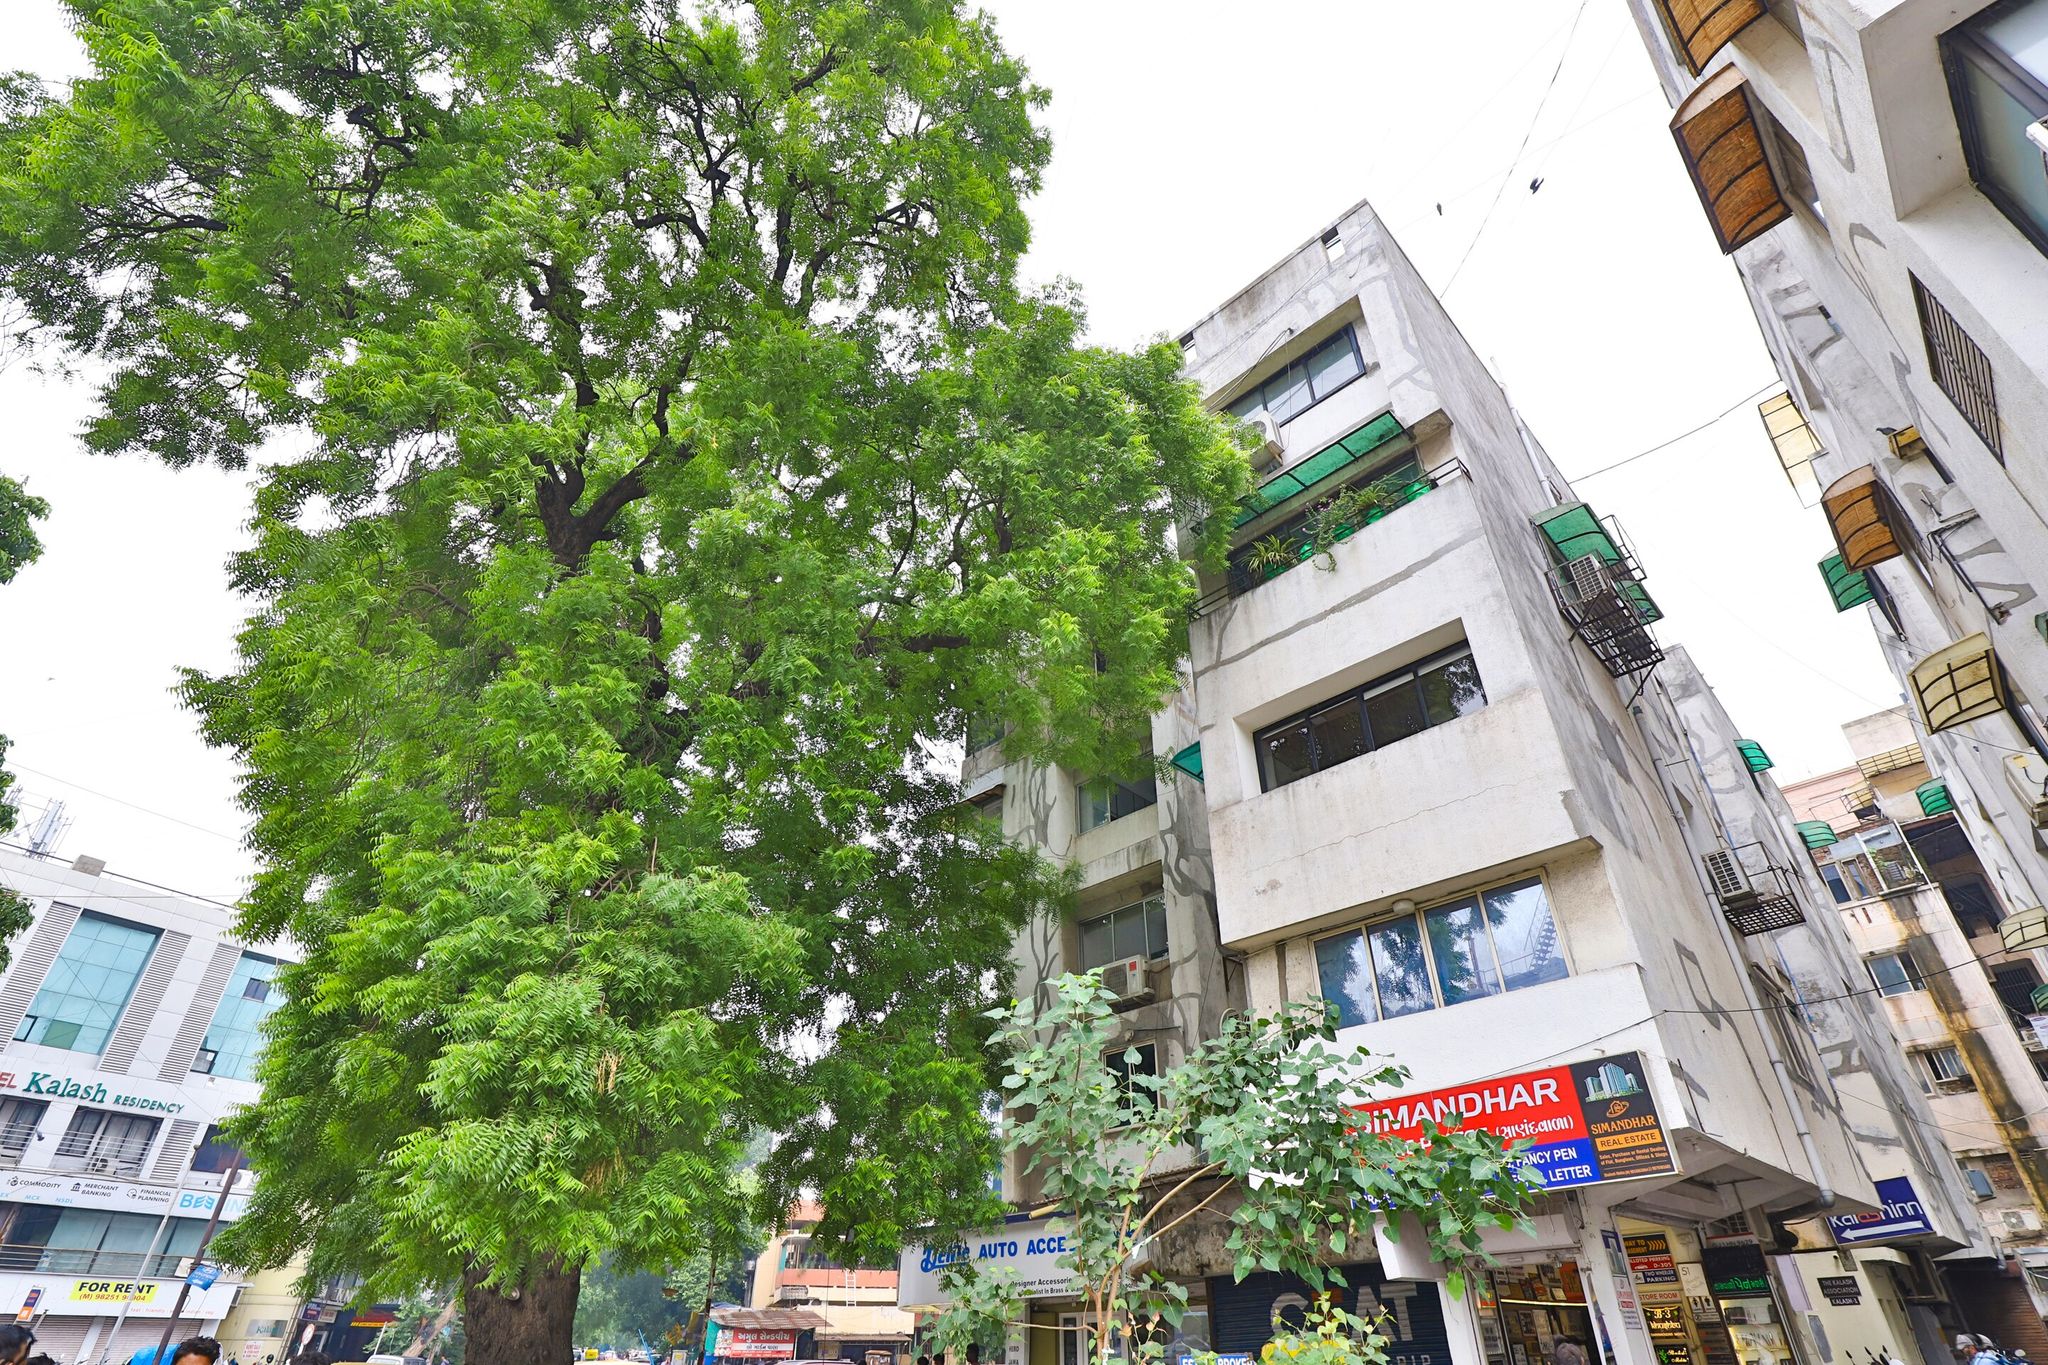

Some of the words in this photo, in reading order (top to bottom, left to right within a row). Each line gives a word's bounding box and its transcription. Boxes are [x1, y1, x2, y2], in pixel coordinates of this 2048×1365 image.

[23, 1072, 107, 1103] Kalash
[113, 1095, 184, 1113] RESIDENCY
[1591, 1115, 1657, 1135] SIMANDHAR
[1600, 1139, 1623, 1148] REAL
[1625, 1132, 1657, 1144] ESTATE
[1553, 1146, 1578, 1162] PEN
[1548, 1164, 1593, 1182] LETTER
[20, 1181, 61, 1189] COMMODITY
[84, 1183, 119, 1191] MERCHANT
[81, 1190, 111, 1198] BANKING
[138, 1195, 170, 1203] PLANNING
[140, 1189, 172, 1197] FINANCIAL
[979, 1240, 1018, 1259] AUTO
[1026, 1236, 1075, 1256] ACCE
[79, 1282, 111, 1293] FOR
[114, 1283, 155, 1294] RENT
[1038, 1276, 1073, 1286] Accessorie
[1270, 1281, 1418, 1342] CAT
